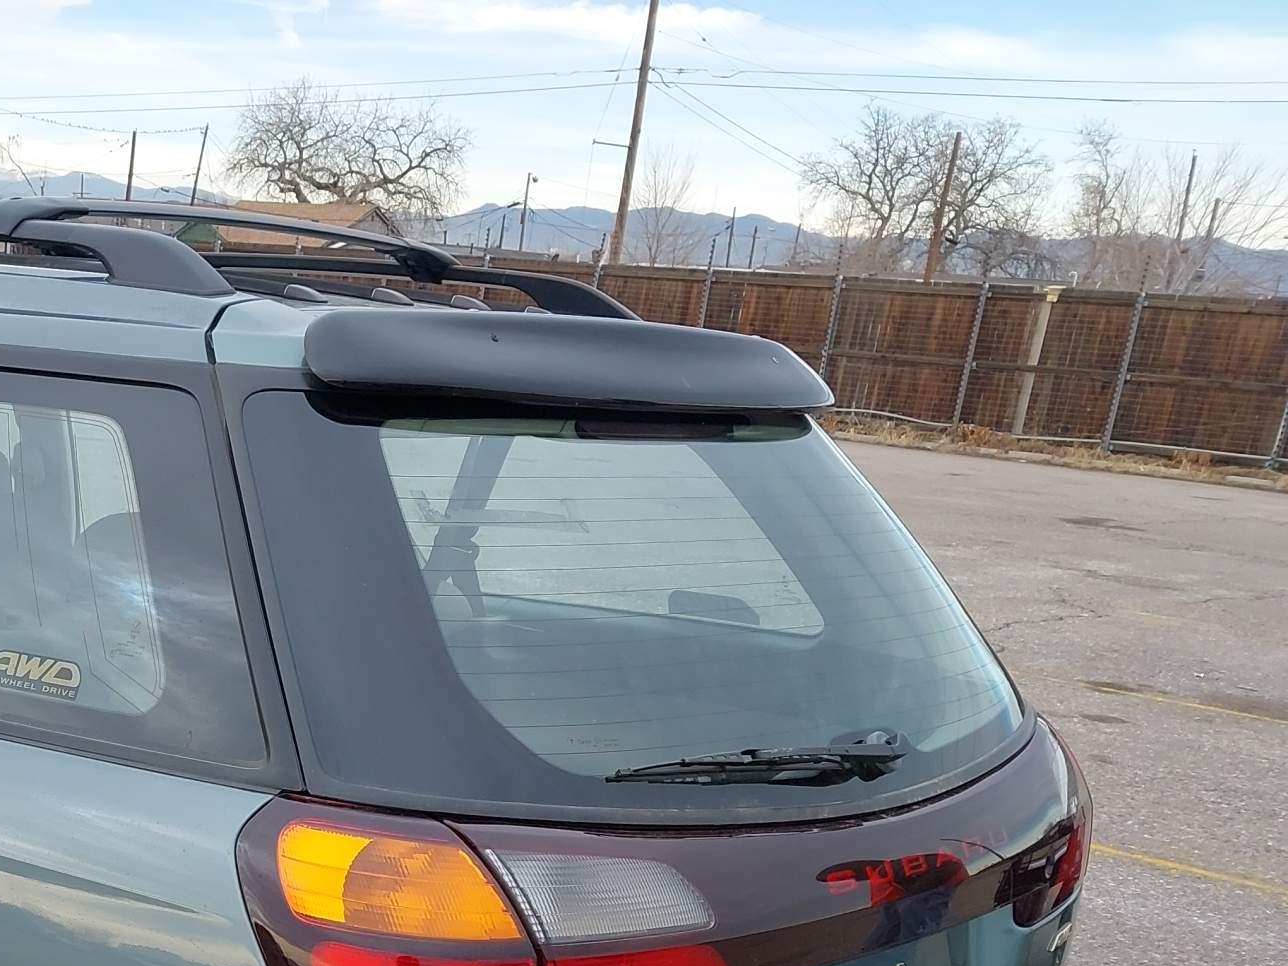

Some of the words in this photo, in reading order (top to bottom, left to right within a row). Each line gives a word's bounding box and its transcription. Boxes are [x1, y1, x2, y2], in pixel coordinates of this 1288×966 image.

[0, 677, 37, 690] WHEEL
[42, 685, 75, 698] DRIVE
[825, 829, 1008, 896] SUBARU
